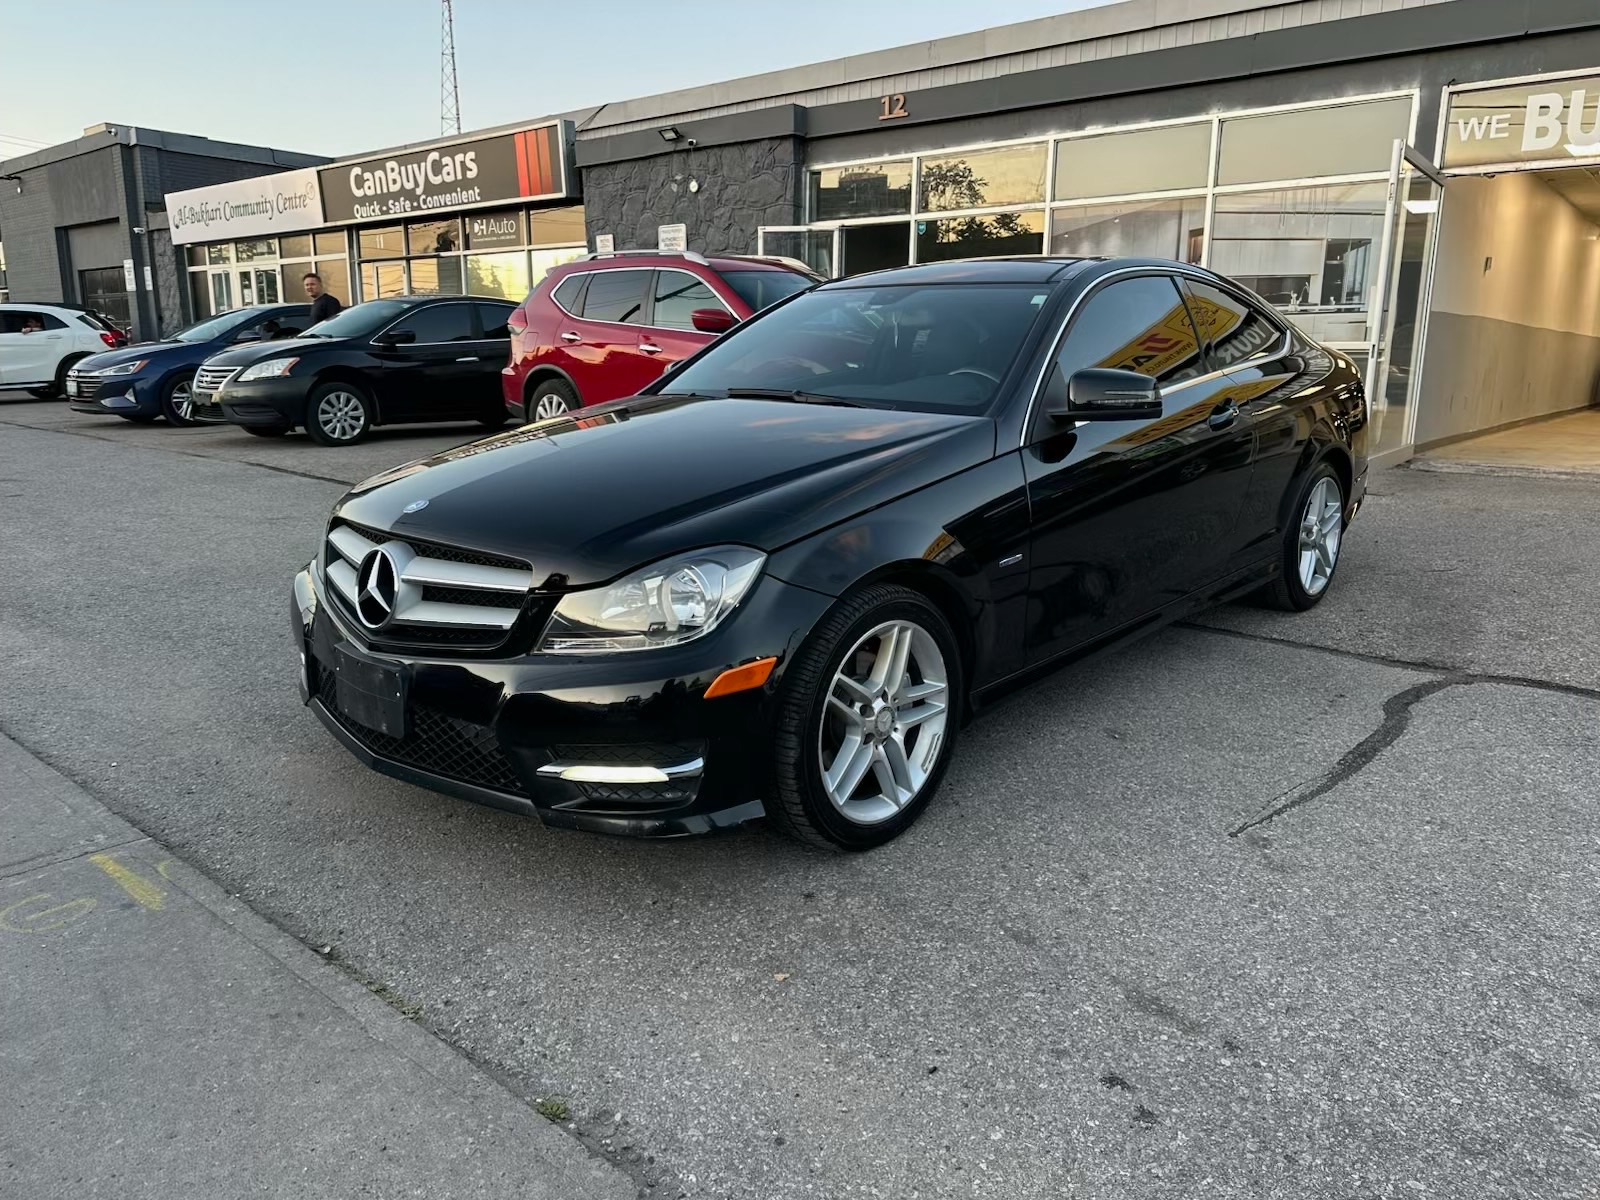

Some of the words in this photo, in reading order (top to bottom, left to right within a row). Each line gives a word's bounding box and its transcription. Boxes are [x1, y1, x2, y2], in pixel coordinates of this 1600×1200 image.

[880, 94, 907, 118] 12
[1458, 114, 1511, 142] WE
[350, 151, 479, 197] CanBuyCars
[173, 201, 222, 229] Al-Bukhari
[223, 195, 274, 220] Community
[276, 192, 308, 214] Centre
[354, 201, 382, 219] Quick
[388, 196, 412, 214] Safe
[419, 186, 481, 209] Convenient
[488, 217, 516, 234] Auto
